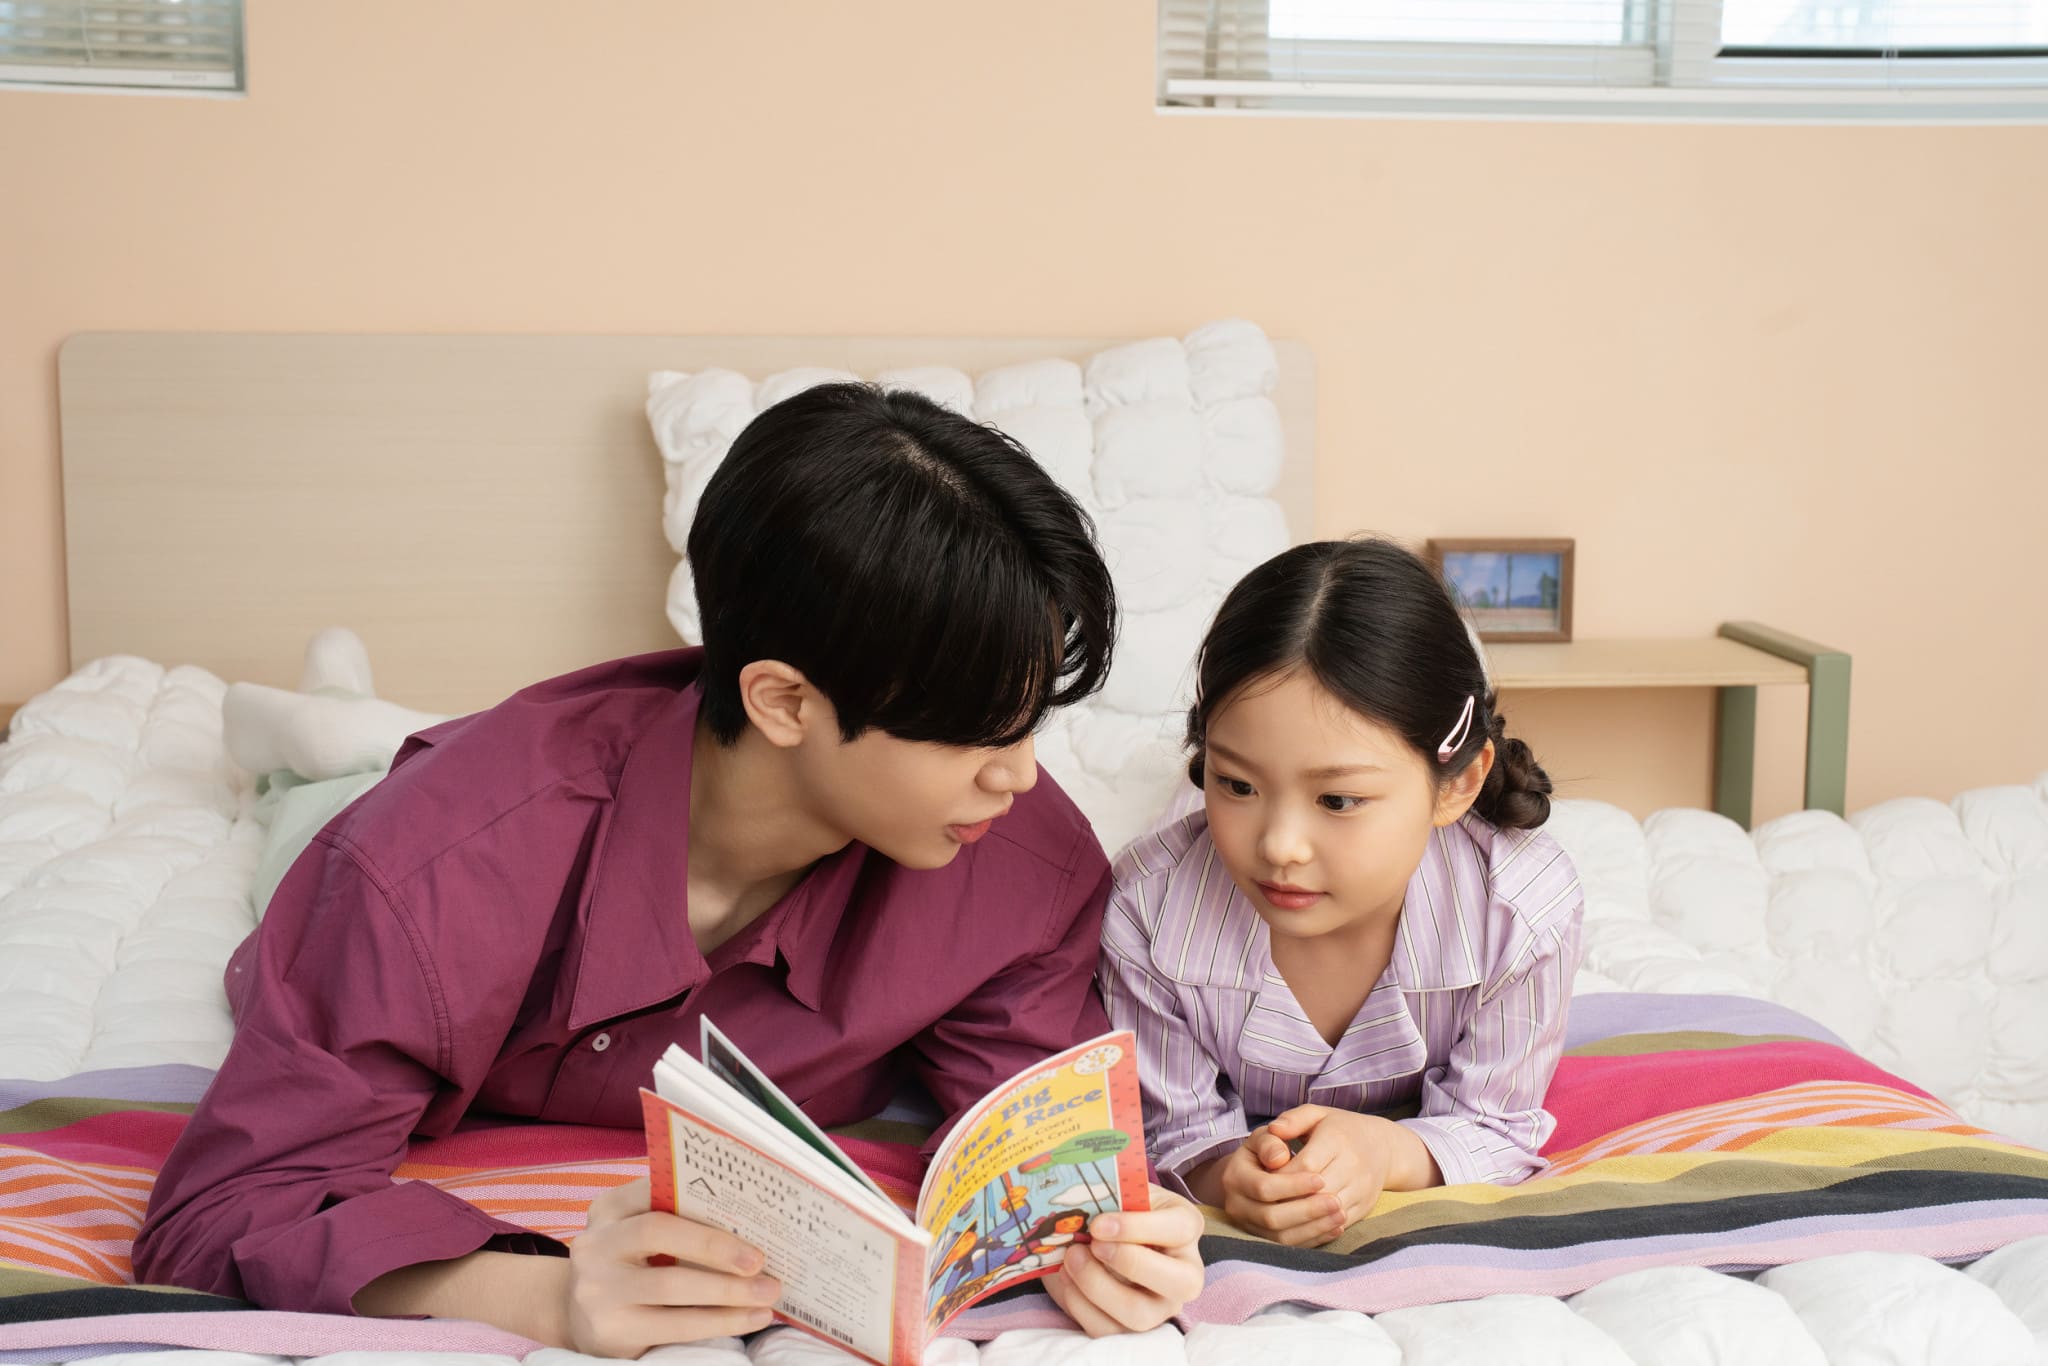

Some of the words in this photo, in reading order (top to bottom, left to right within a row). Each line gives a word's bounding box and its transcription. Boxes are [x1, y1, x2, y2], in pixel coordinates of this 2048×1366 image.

[950, 1124, 991, 1172] The
[1001, 1086, 1052, 1124] Big
[1024, 1089, 1103, 1129] Race
[684, 1139, 785, 1202] balloon
[685, 1153, 744, 1192] hard
